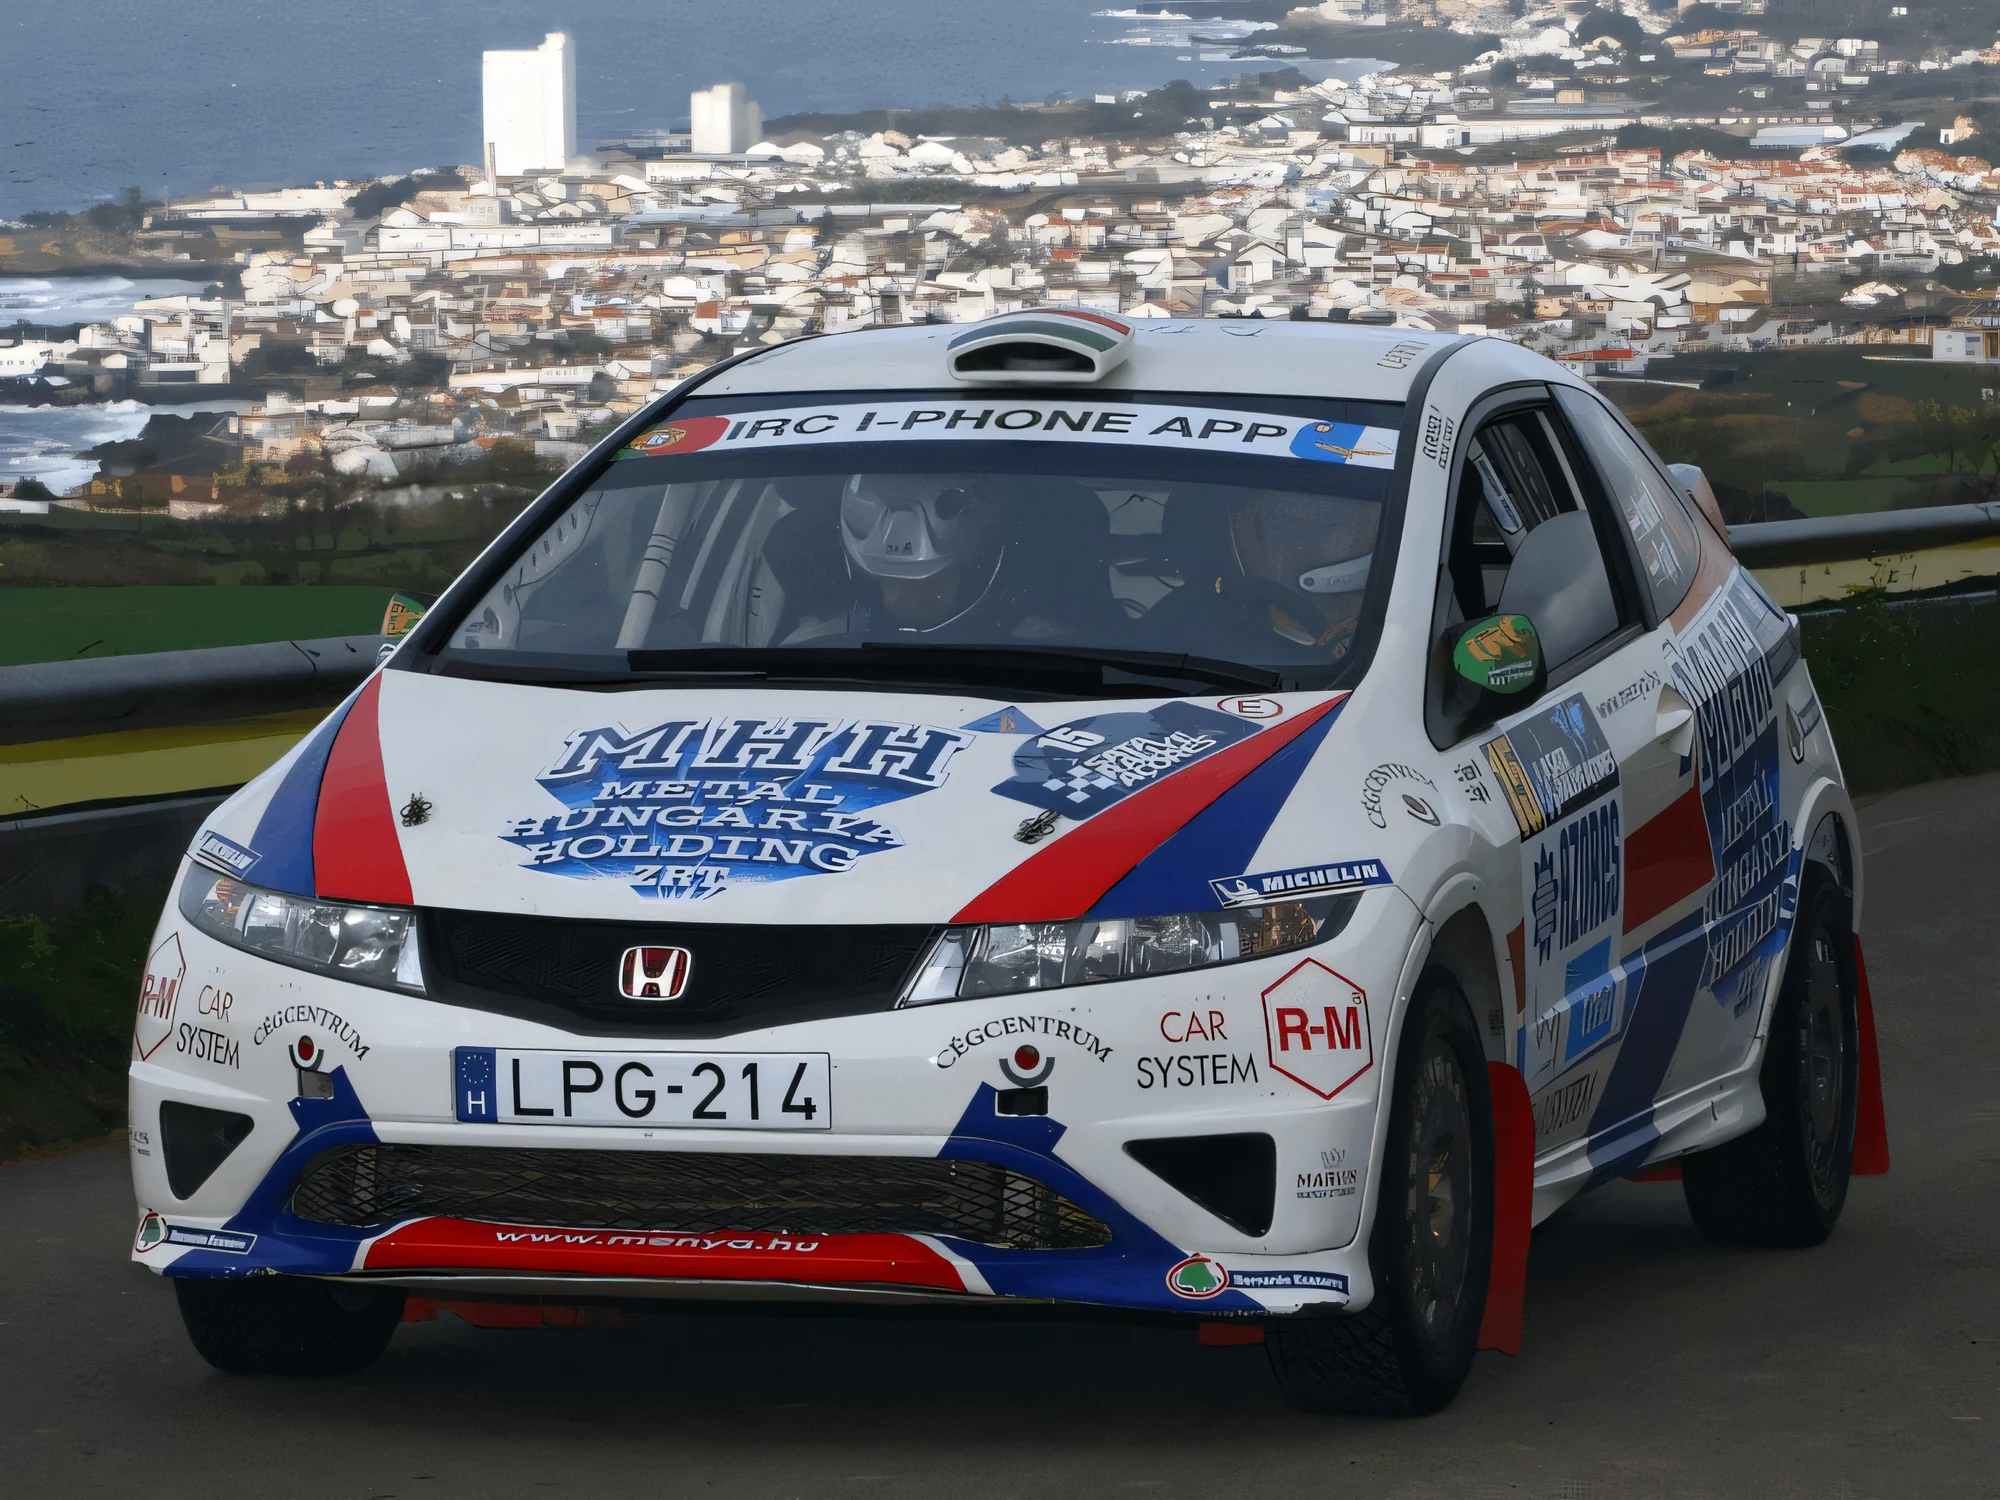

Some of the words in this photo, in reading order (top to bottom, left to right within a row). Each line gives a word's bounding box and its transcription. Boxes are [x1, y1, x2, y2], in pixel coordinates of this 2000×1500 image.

[726, 414, 839, 440] IRC
[856, 409, 1138, 433] I-PHONE
[1149, 415, 1288, 443] APP
[1237, 700, 1264, 715] E
[541, 717, 970, 785] MHH
[1036, 727, 1105, 753] 15
[1084, 737, 1156, 767] SATA
[520, 834, 860, 872] HOLDING
[1262, 864, 1379, 892] MICHELIN
[198, 985, 233, 1023] CAR
[253, 1005, 371, 1061] CÉGCENTRUM
[936, 1015, 1114, 1069] CÉGCENTRUM
[1160, 1010, 1228, 1043] CAR
[1276, 1006, 1362, 1052] R-M
[176, 1022, 240, 1070] SYSTEM
[467, 1090, 486, 1115] H
[511, 1057, 818, 1121] LPG-214
[1137, 1053, 1259, 1089] SYSTEM
